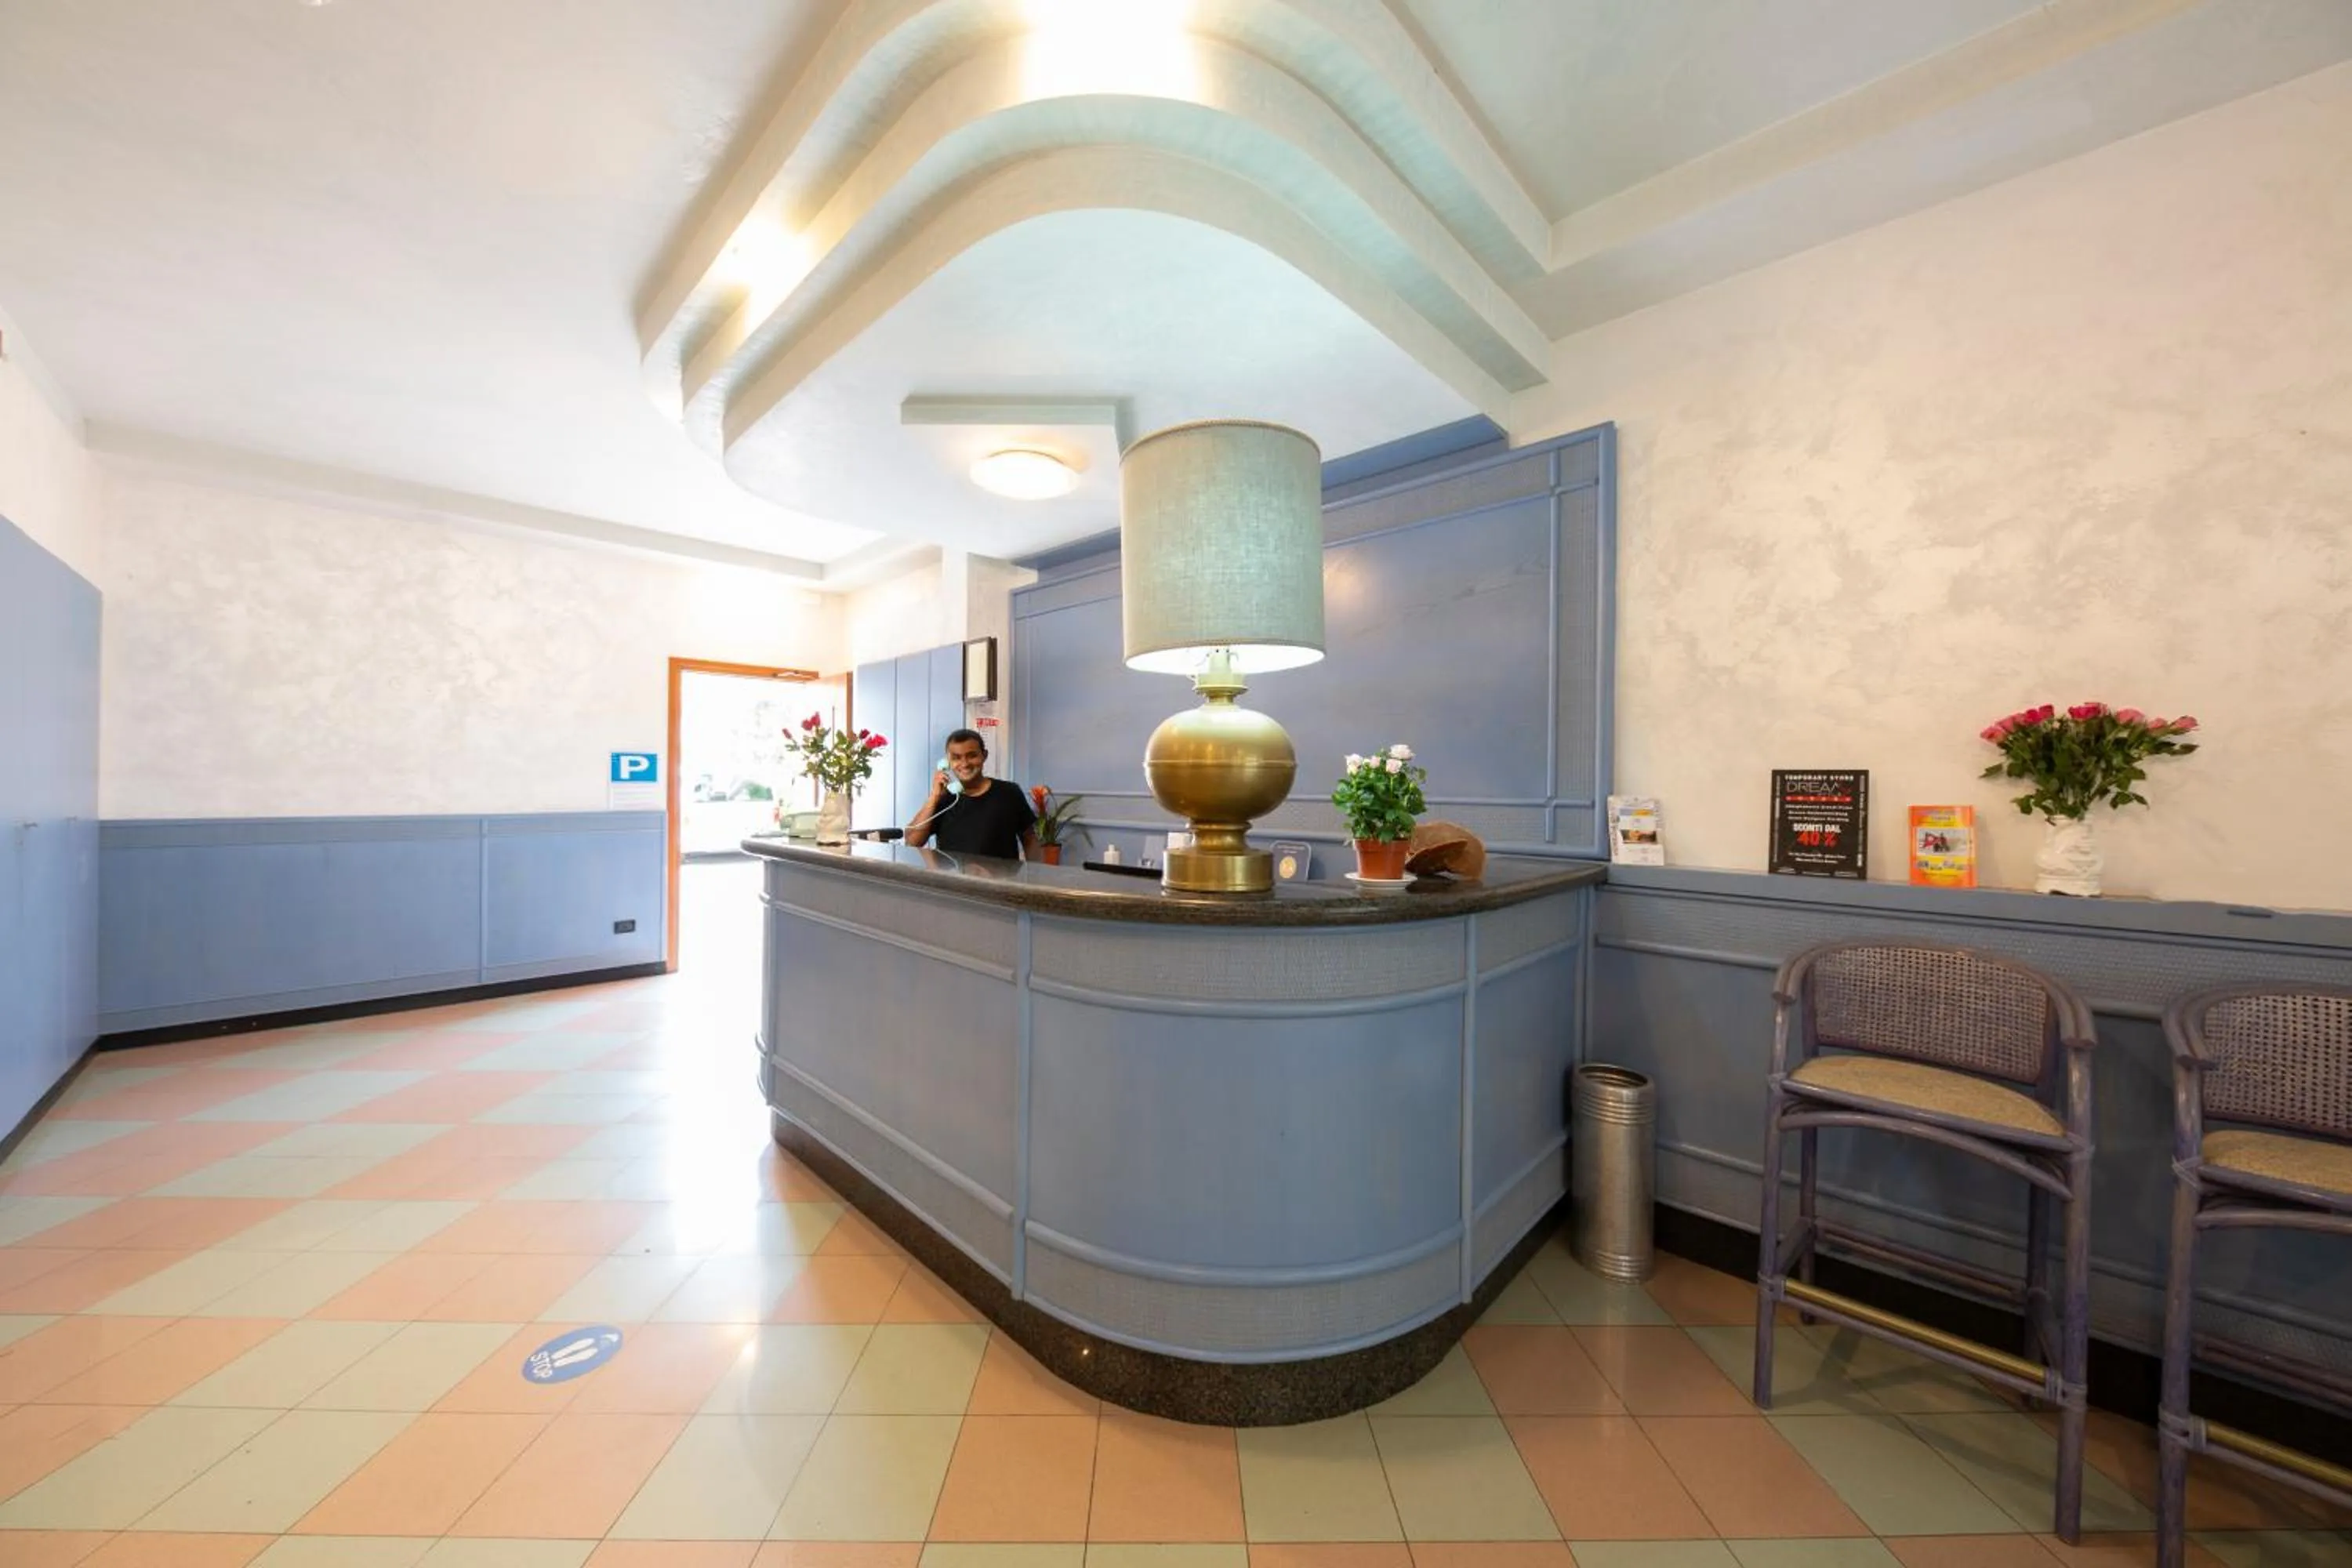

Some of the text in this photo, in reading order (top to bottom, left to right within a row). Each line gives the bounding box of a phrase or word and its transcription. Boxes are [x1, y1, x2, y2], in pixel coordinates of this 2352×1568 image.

[619, 755, 650, 779] P
[1793, 823, 1842, 833] SCONTI DAL
[1797, 831, 1820, 846] 40
